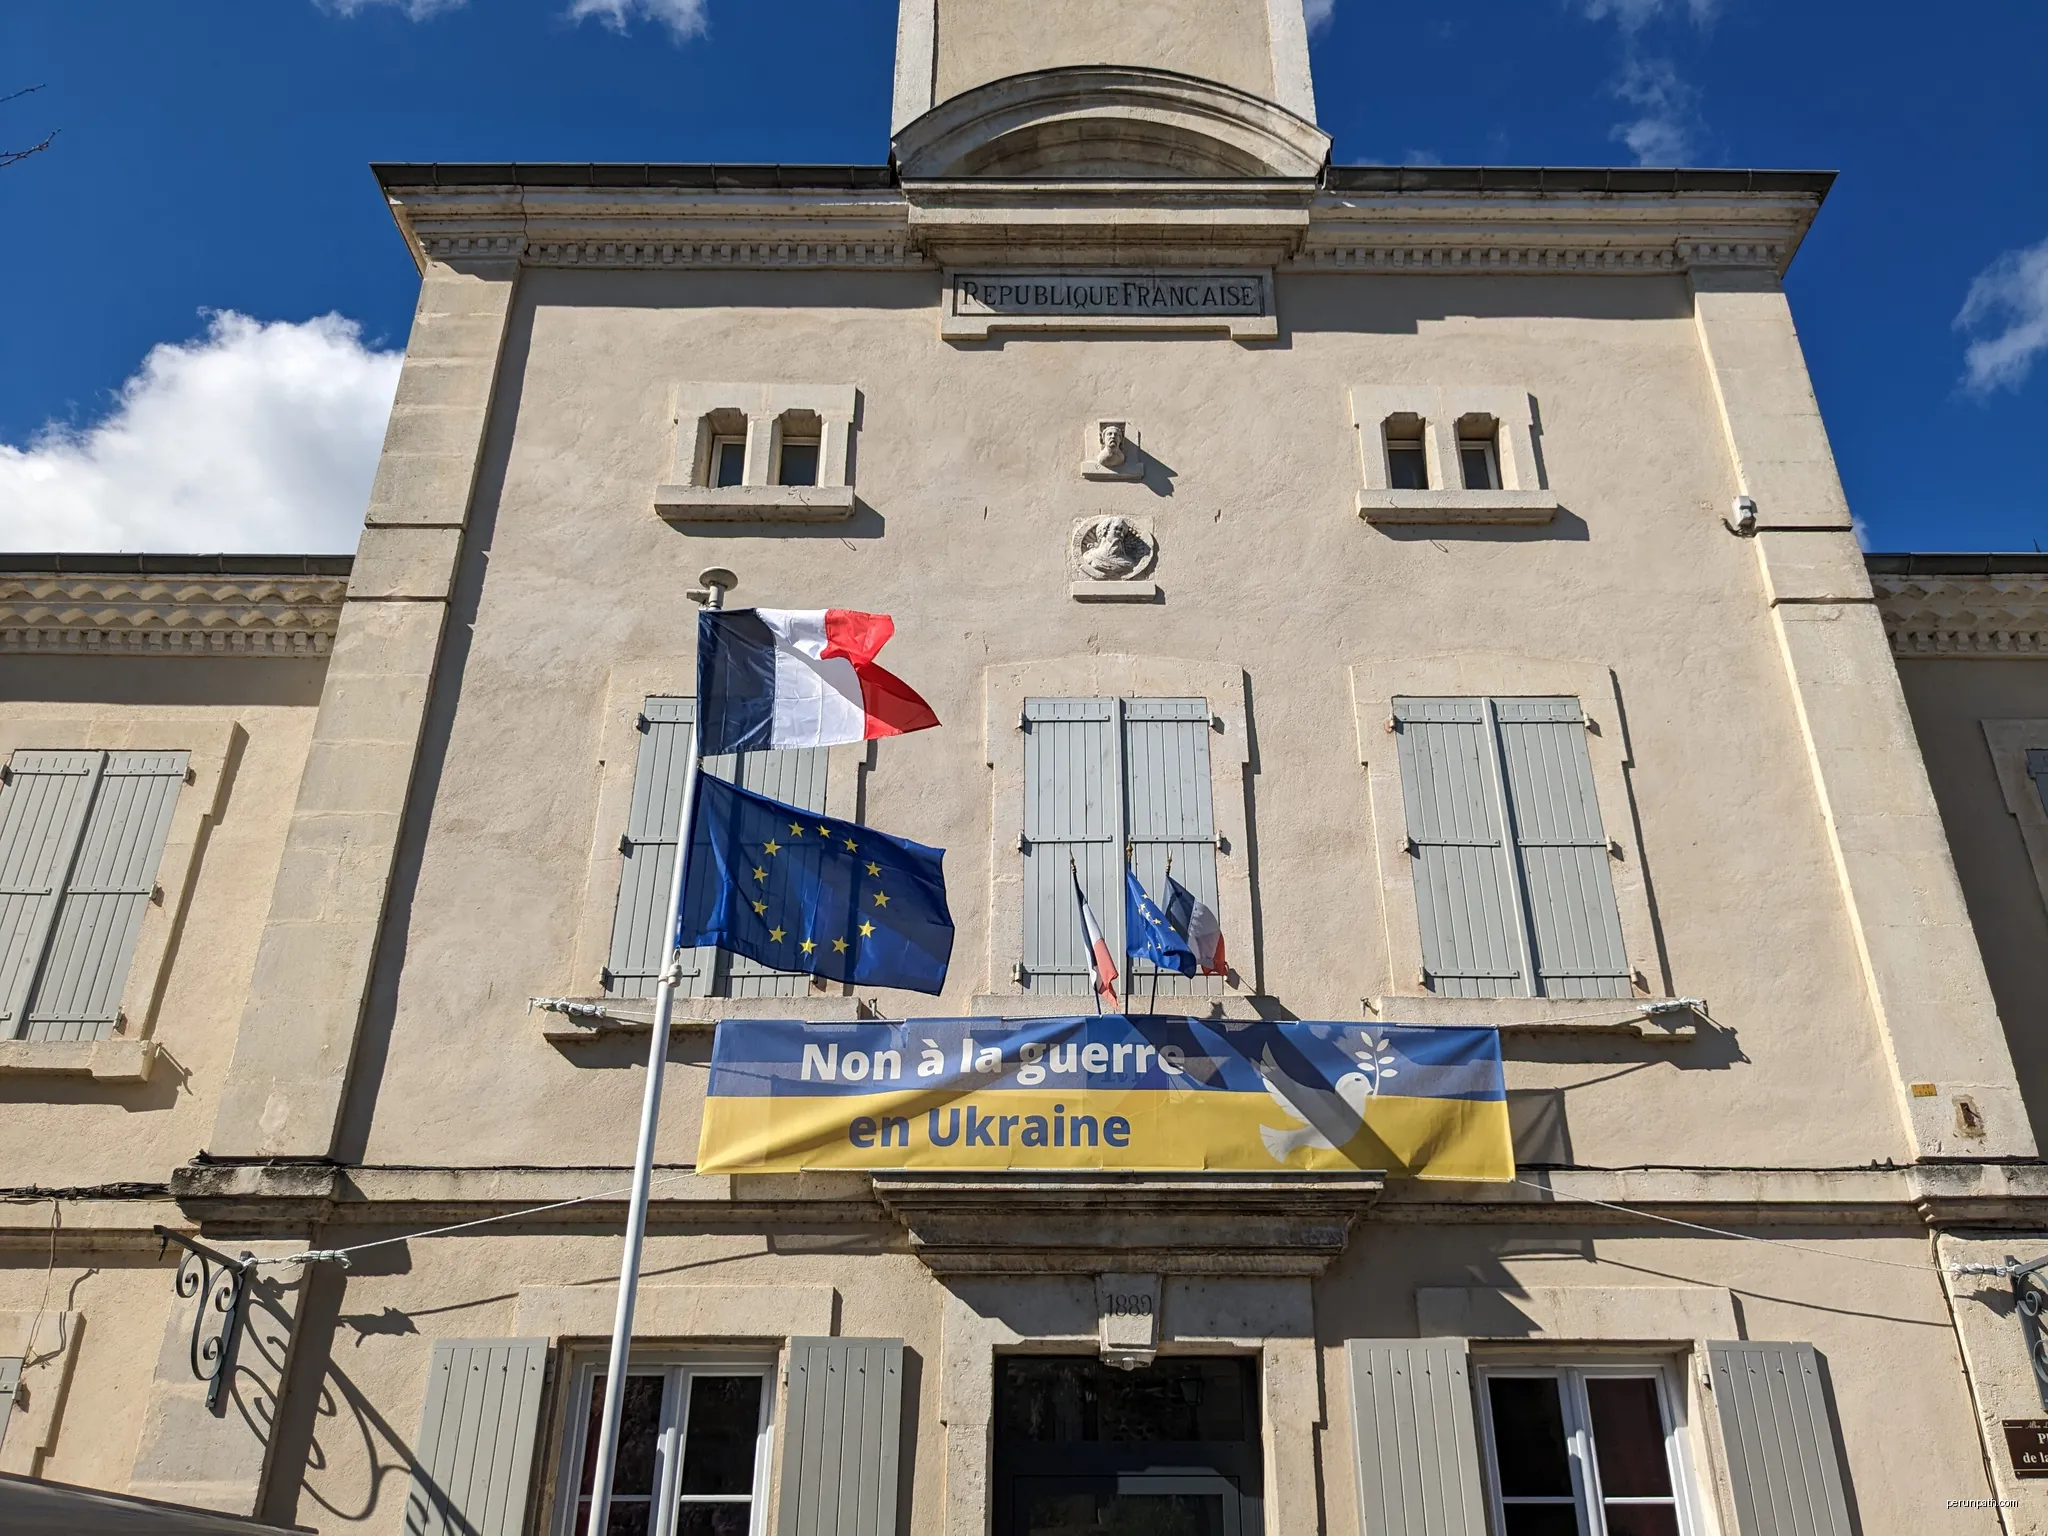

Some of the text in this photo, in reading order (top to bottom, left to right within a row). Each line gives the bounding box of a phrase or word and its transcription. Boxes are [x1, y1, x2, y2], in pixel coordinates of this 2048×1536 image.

[800, 1038, 1186, 1086] Non à la guerre
[849, 1104, 1131, 1148] en Ukraine
[1106, 1294, 1153, 1318] 1889
[2022, 1451, 2037, 1463] de
